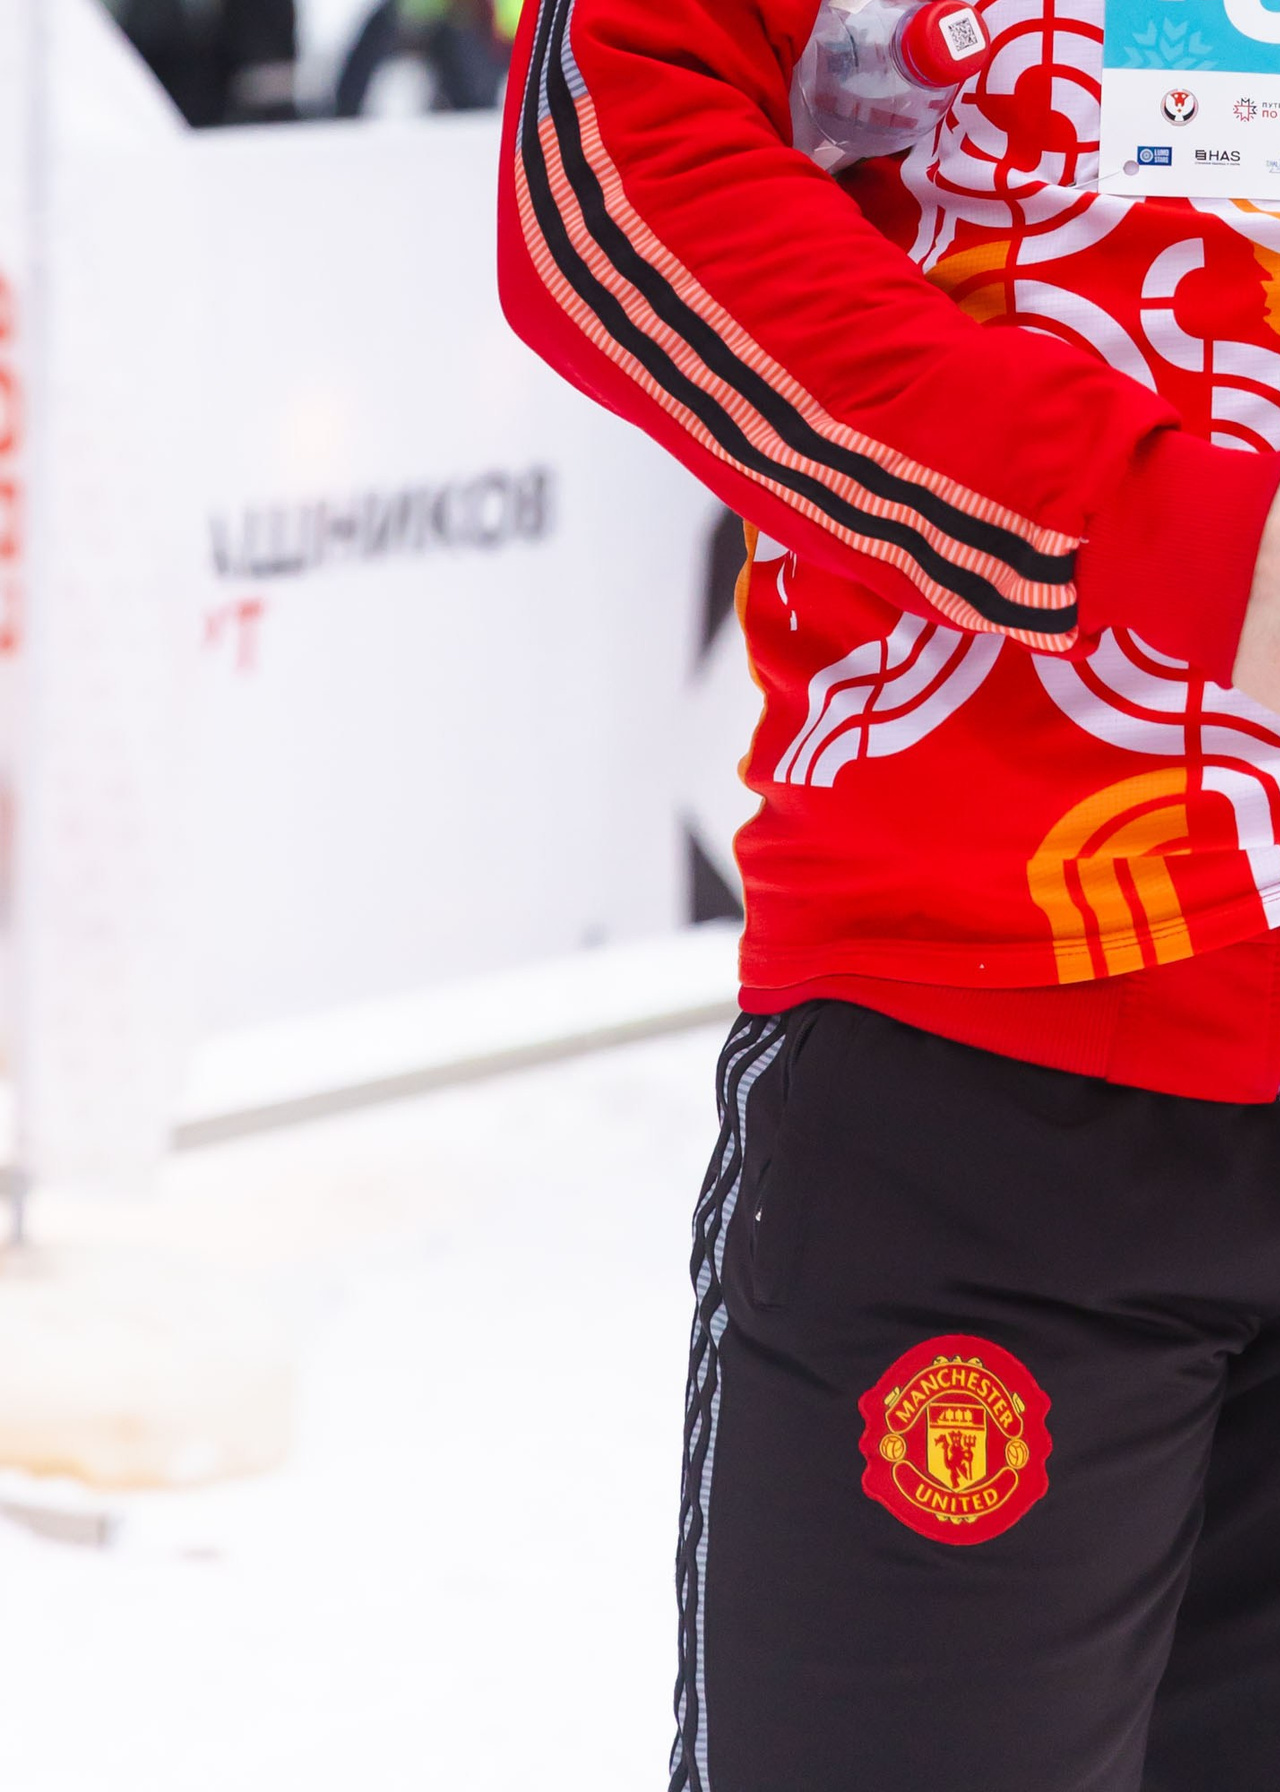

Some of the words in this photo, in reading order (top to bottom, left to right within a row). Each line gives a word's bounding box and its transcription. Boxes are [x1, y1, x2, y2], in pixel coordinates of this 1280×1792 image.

[1262, 110, 1278, 119] ПО
[1209, 150, 1241, 161] HAS
[896, 1369, 1013, 1428] MANCHESTER
[915, 1484, 998, 1513] UNITED
